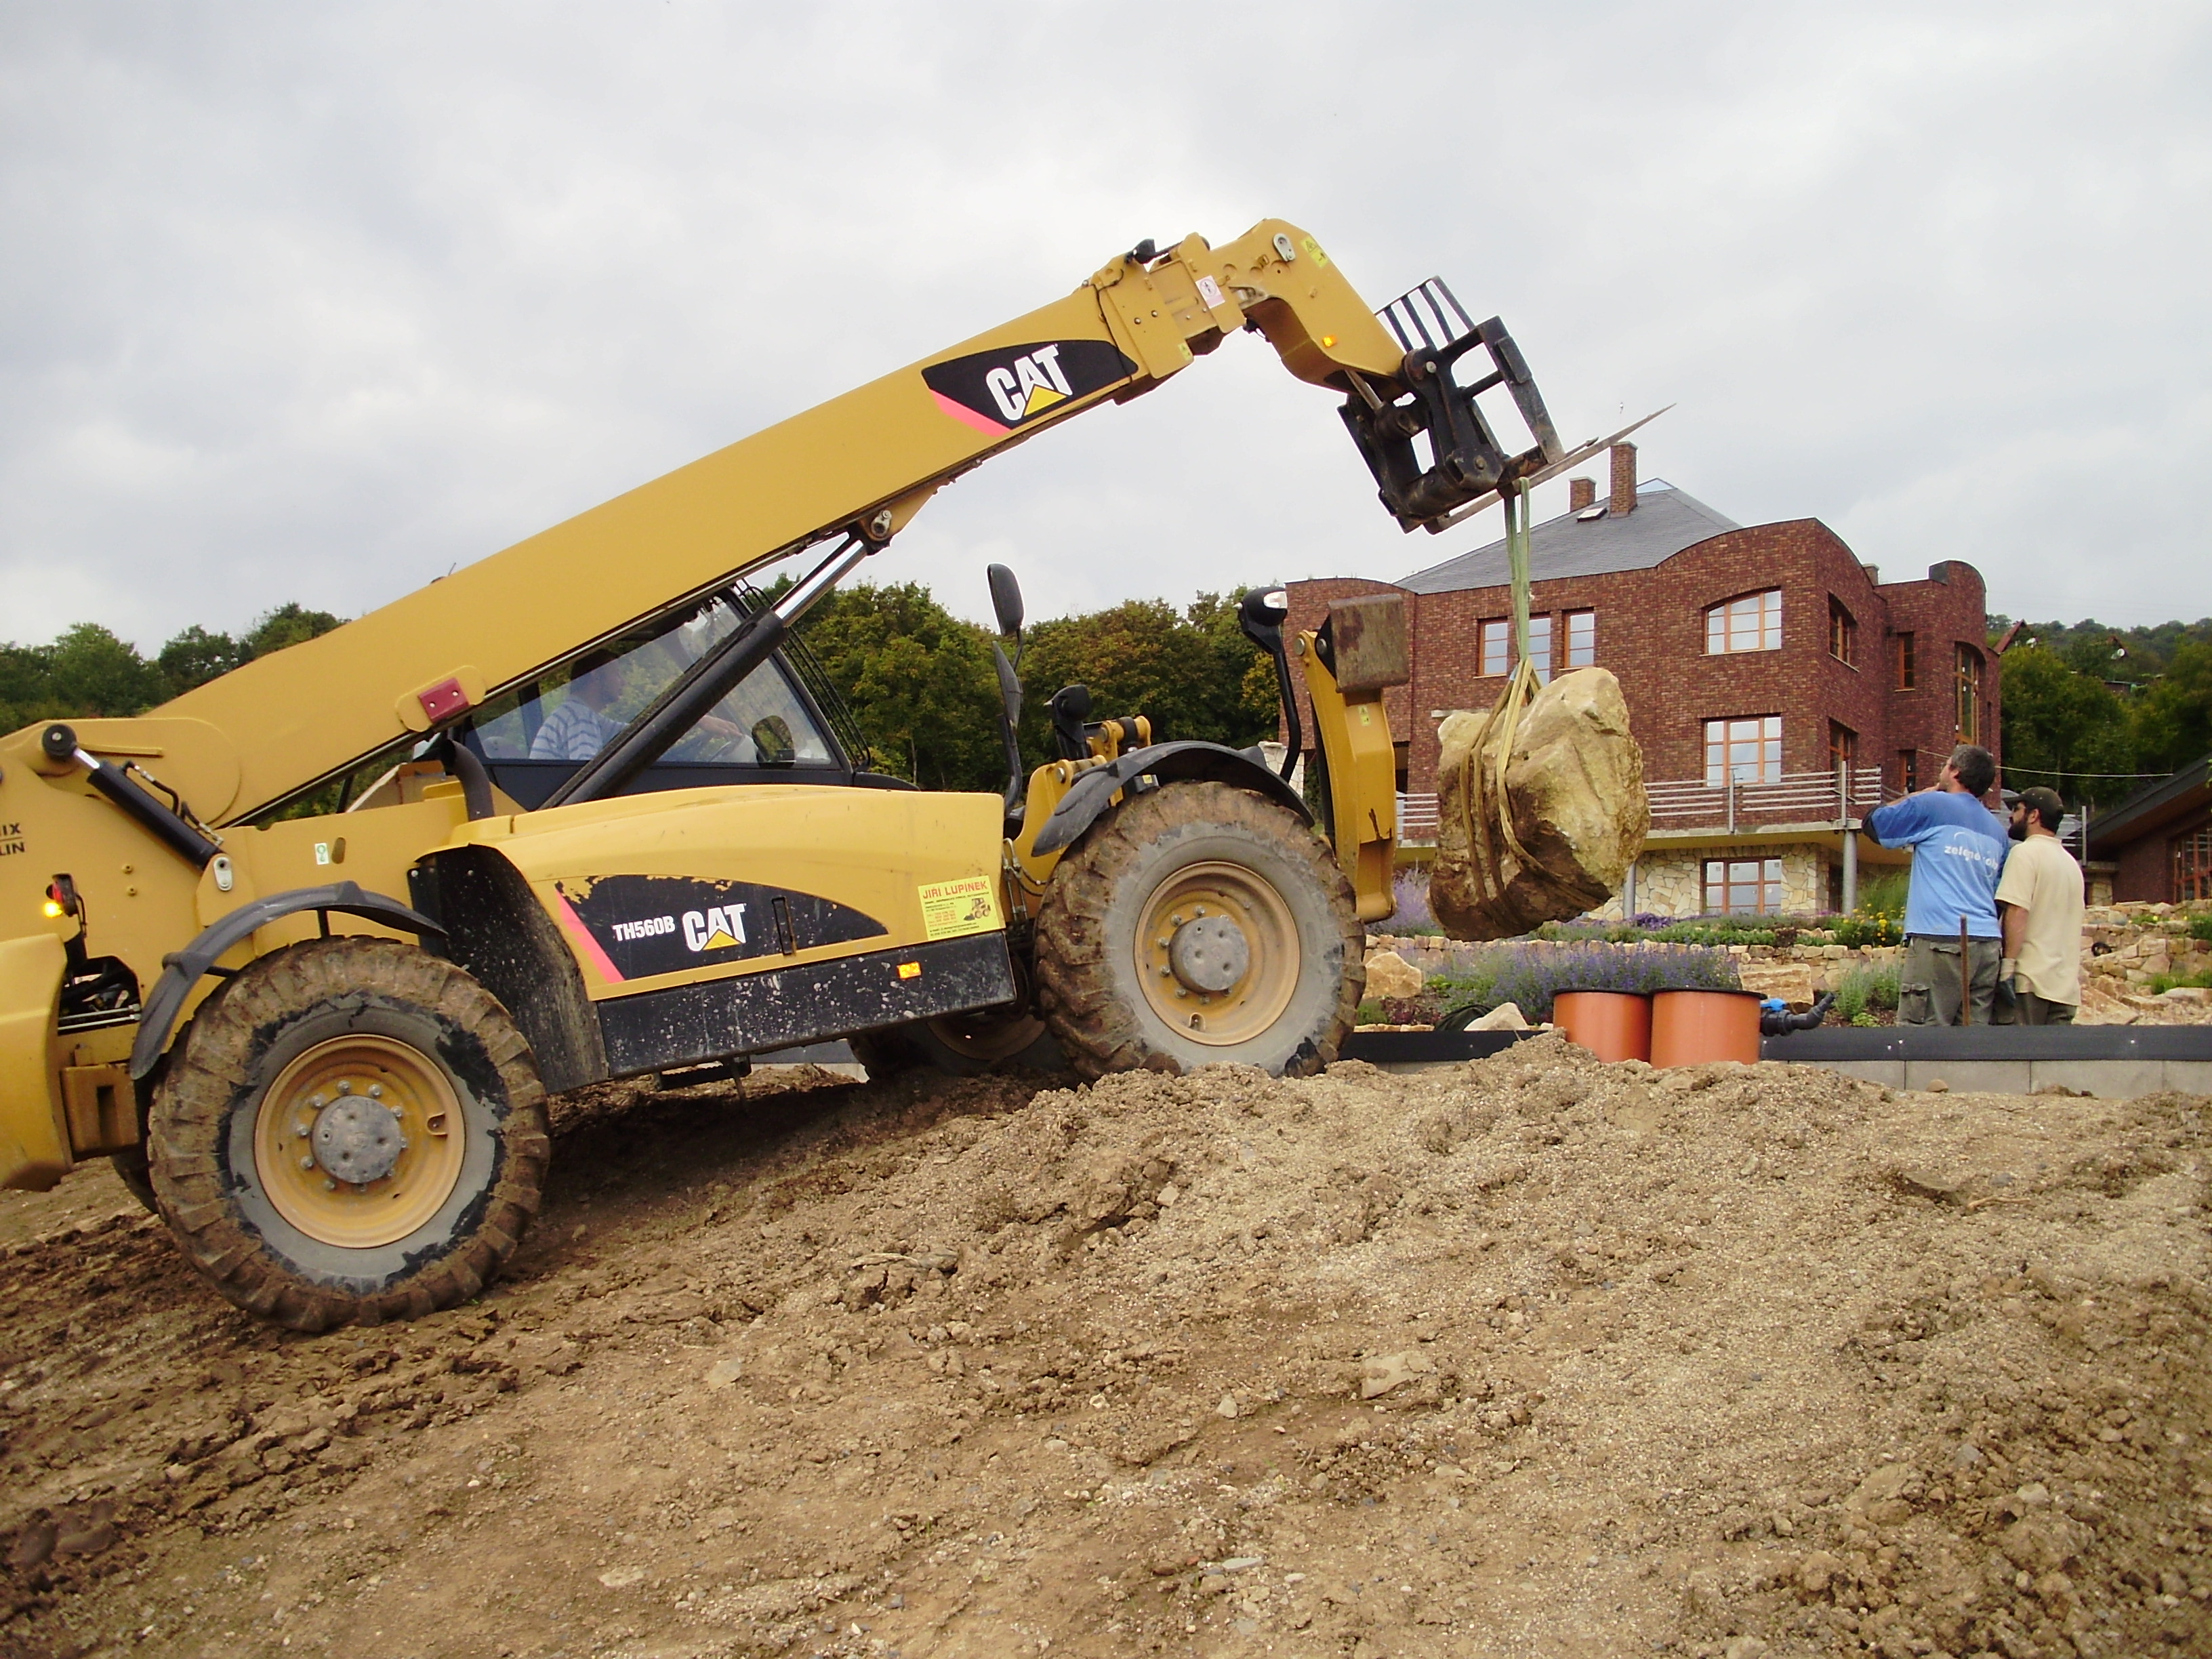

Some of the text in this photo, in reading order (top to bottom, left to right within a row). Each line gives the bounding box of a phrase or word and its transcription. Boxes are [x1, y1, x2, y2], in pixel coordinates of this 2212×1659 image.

[985, 343, 1073, 421] CAT
[0, 822, 22, 836] IX
[613, 903, 746, 952] TH560B CAT
